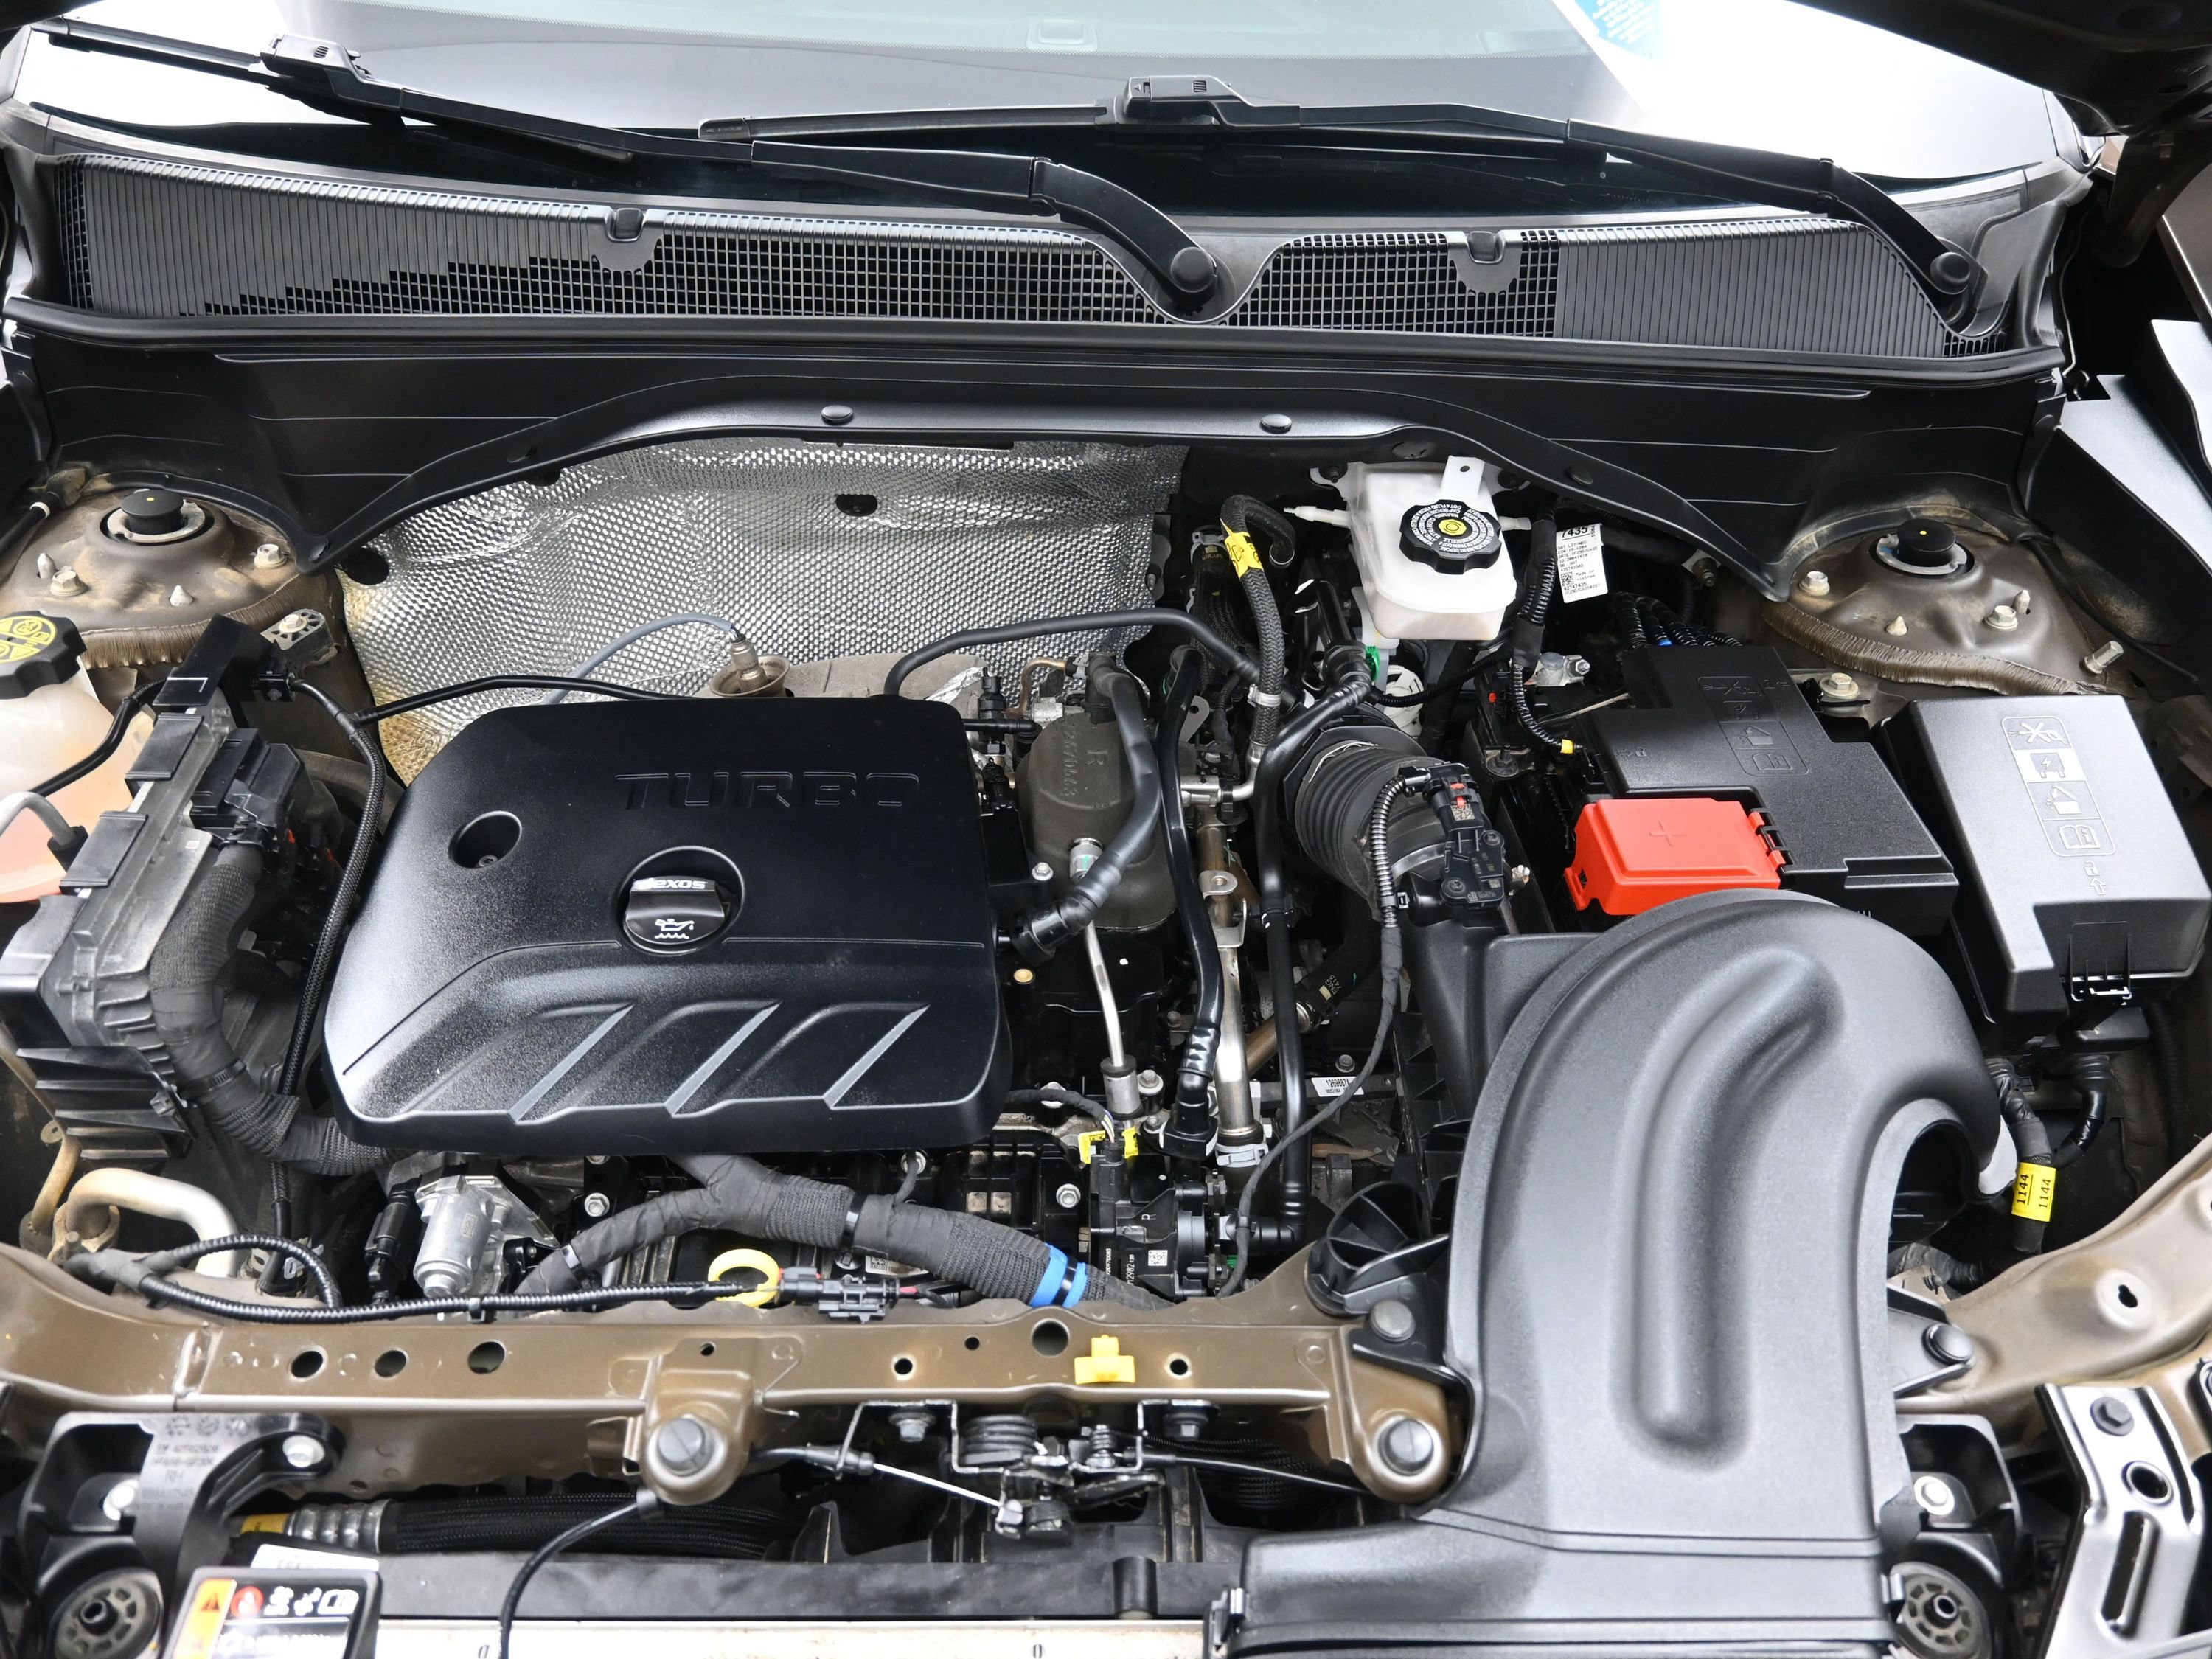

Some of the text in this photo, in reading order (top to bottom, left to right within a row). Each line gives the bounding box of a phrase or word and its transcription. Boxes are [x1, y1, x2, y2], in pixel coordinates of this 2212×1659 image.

[615, 771, 919, 809] TURBO
[2017, 1174, 2029, 1205] 1144
[2038, 1178, 2051, 1209] 1144
